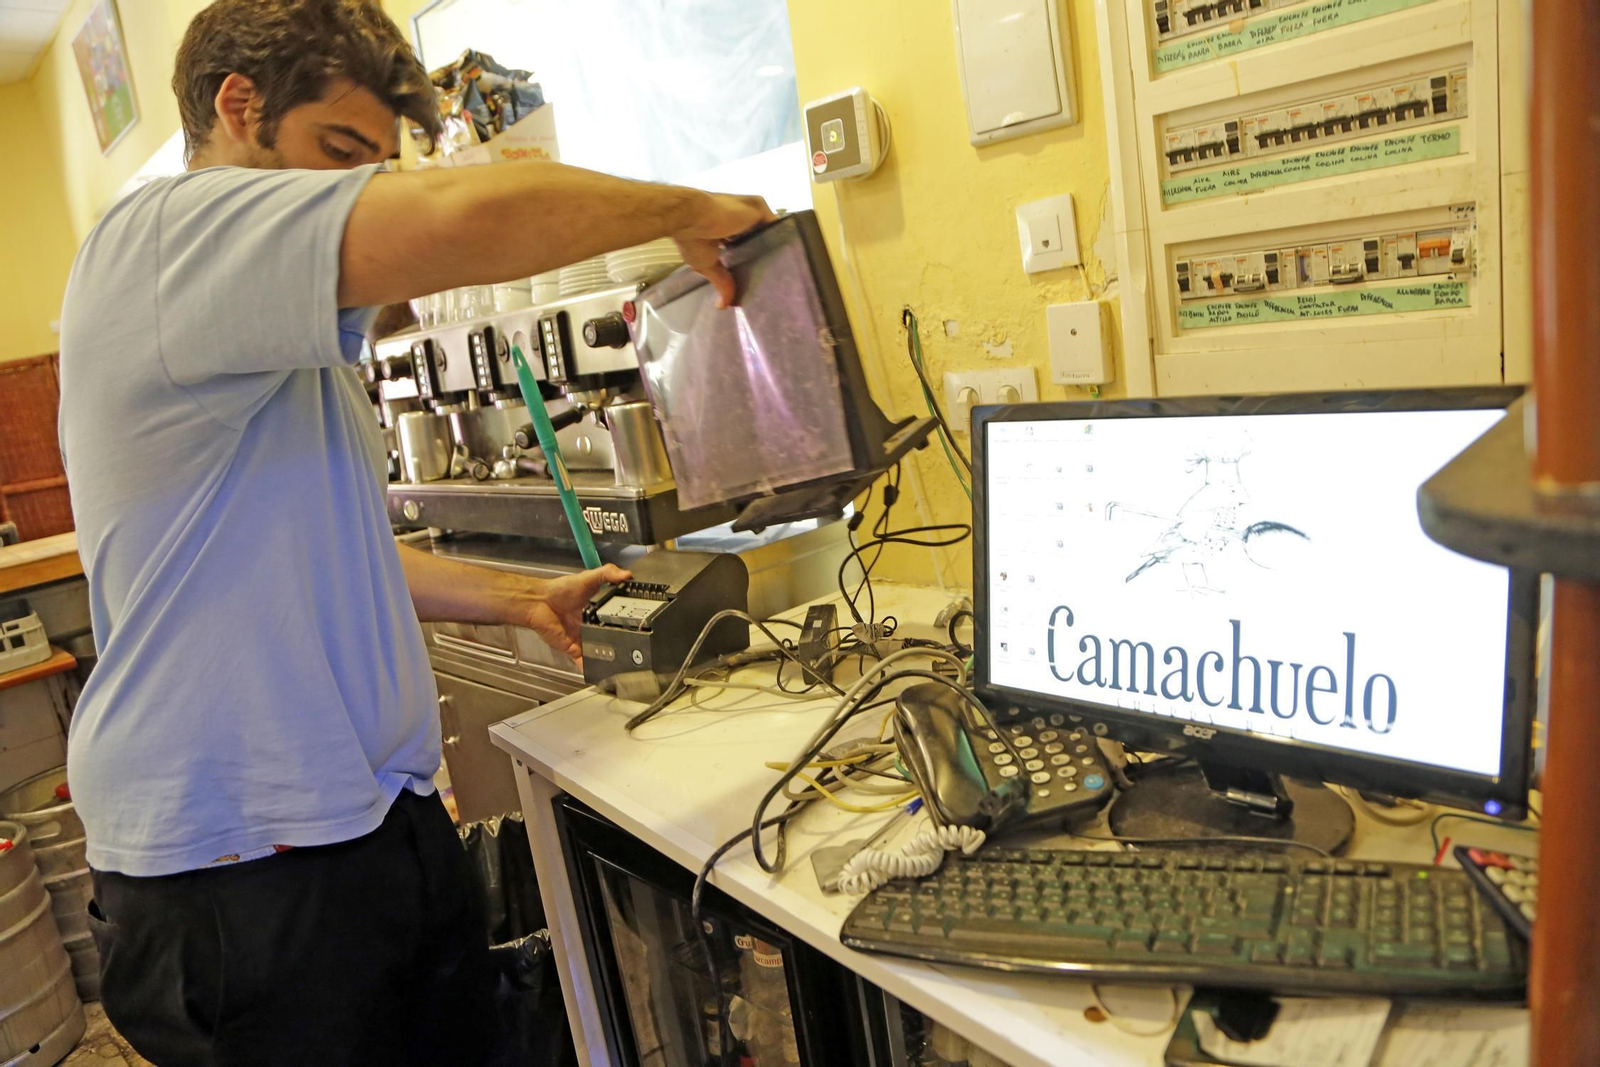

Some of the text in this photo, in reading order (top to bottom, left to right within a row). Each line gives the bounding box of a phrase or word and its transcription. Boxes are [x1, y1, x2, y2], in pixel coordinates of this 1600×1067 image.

[1420, 131, 1451, 145] TERMO
[583, 506, 629, 535] WEGA
[1047, 605, 1398, 735] Camachuelo
[1183, 724, 1217, 740] acer
